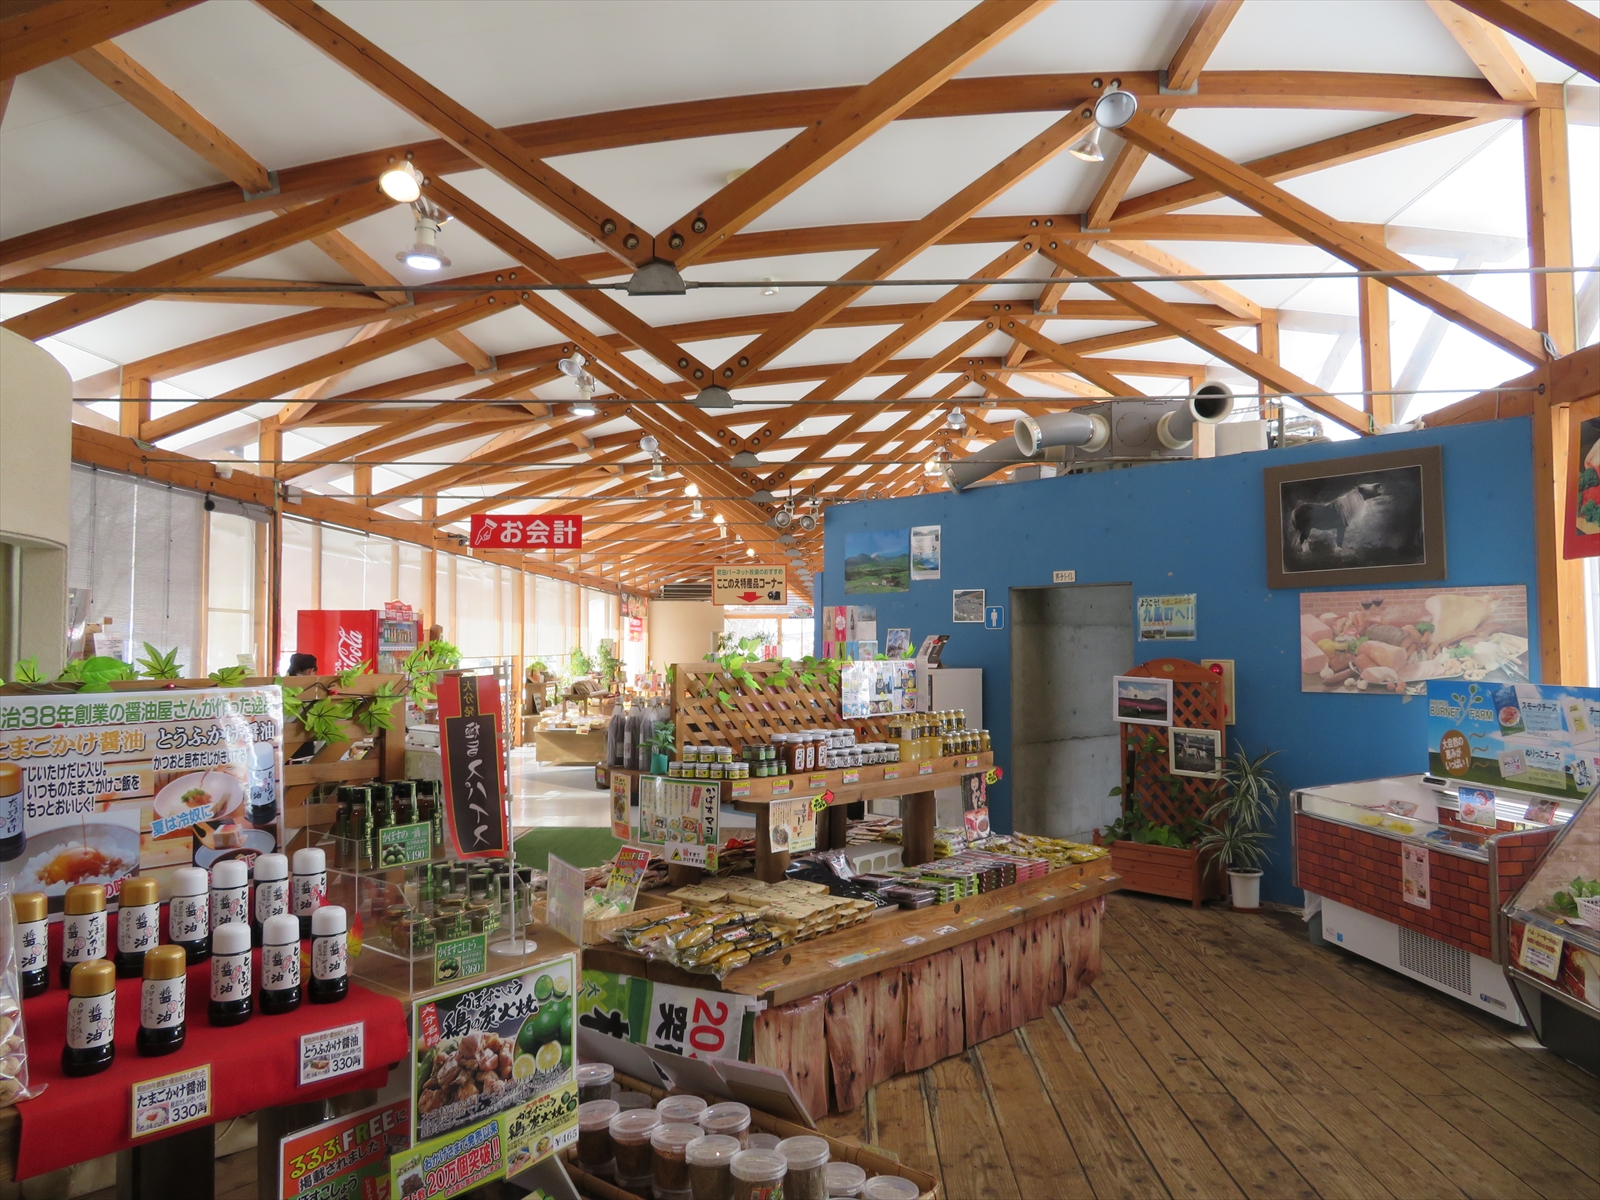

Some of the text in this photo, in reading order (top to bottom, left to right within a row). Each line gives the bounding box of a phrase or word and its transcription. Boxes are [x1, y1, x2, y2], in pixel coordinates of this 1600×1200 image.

[500, 520, 577, 544] お会計
[717, 578, 783, 589] ここのえ特産品コーナー
[0, 696, 272, 729] 治38年創業の醤油屋さんが作った逸
[1430, 706, 1494, 720] BURNET FARM
[1522, 702, 1558, 712] スモークチーズ
[1442, 737, 1464, 749] 大自然の
[1525, 749, 1561, 760] ぬりっこチーズ
[27, 775, 140, 800] いつものたまごかけご飯を
[152, 805, 213, 837] 夏は冷奴に
[705, 787, 716, 836] かぼすマヨ
[456, 979, 524, 1010] かぼすこしょう
[421, 1006, 441, 1046] 大分名物
[440, 993, 539, 1041] 鶏の炭火焼
[304, 1034, 359, 1059] とうふかけ醤油
[137, 1078, 207, 1109] たまごかけ醤油
[424, 1120, 499, 1171] おかげさまで発売以来
[555, 1129, 578, 1147] ¥465
